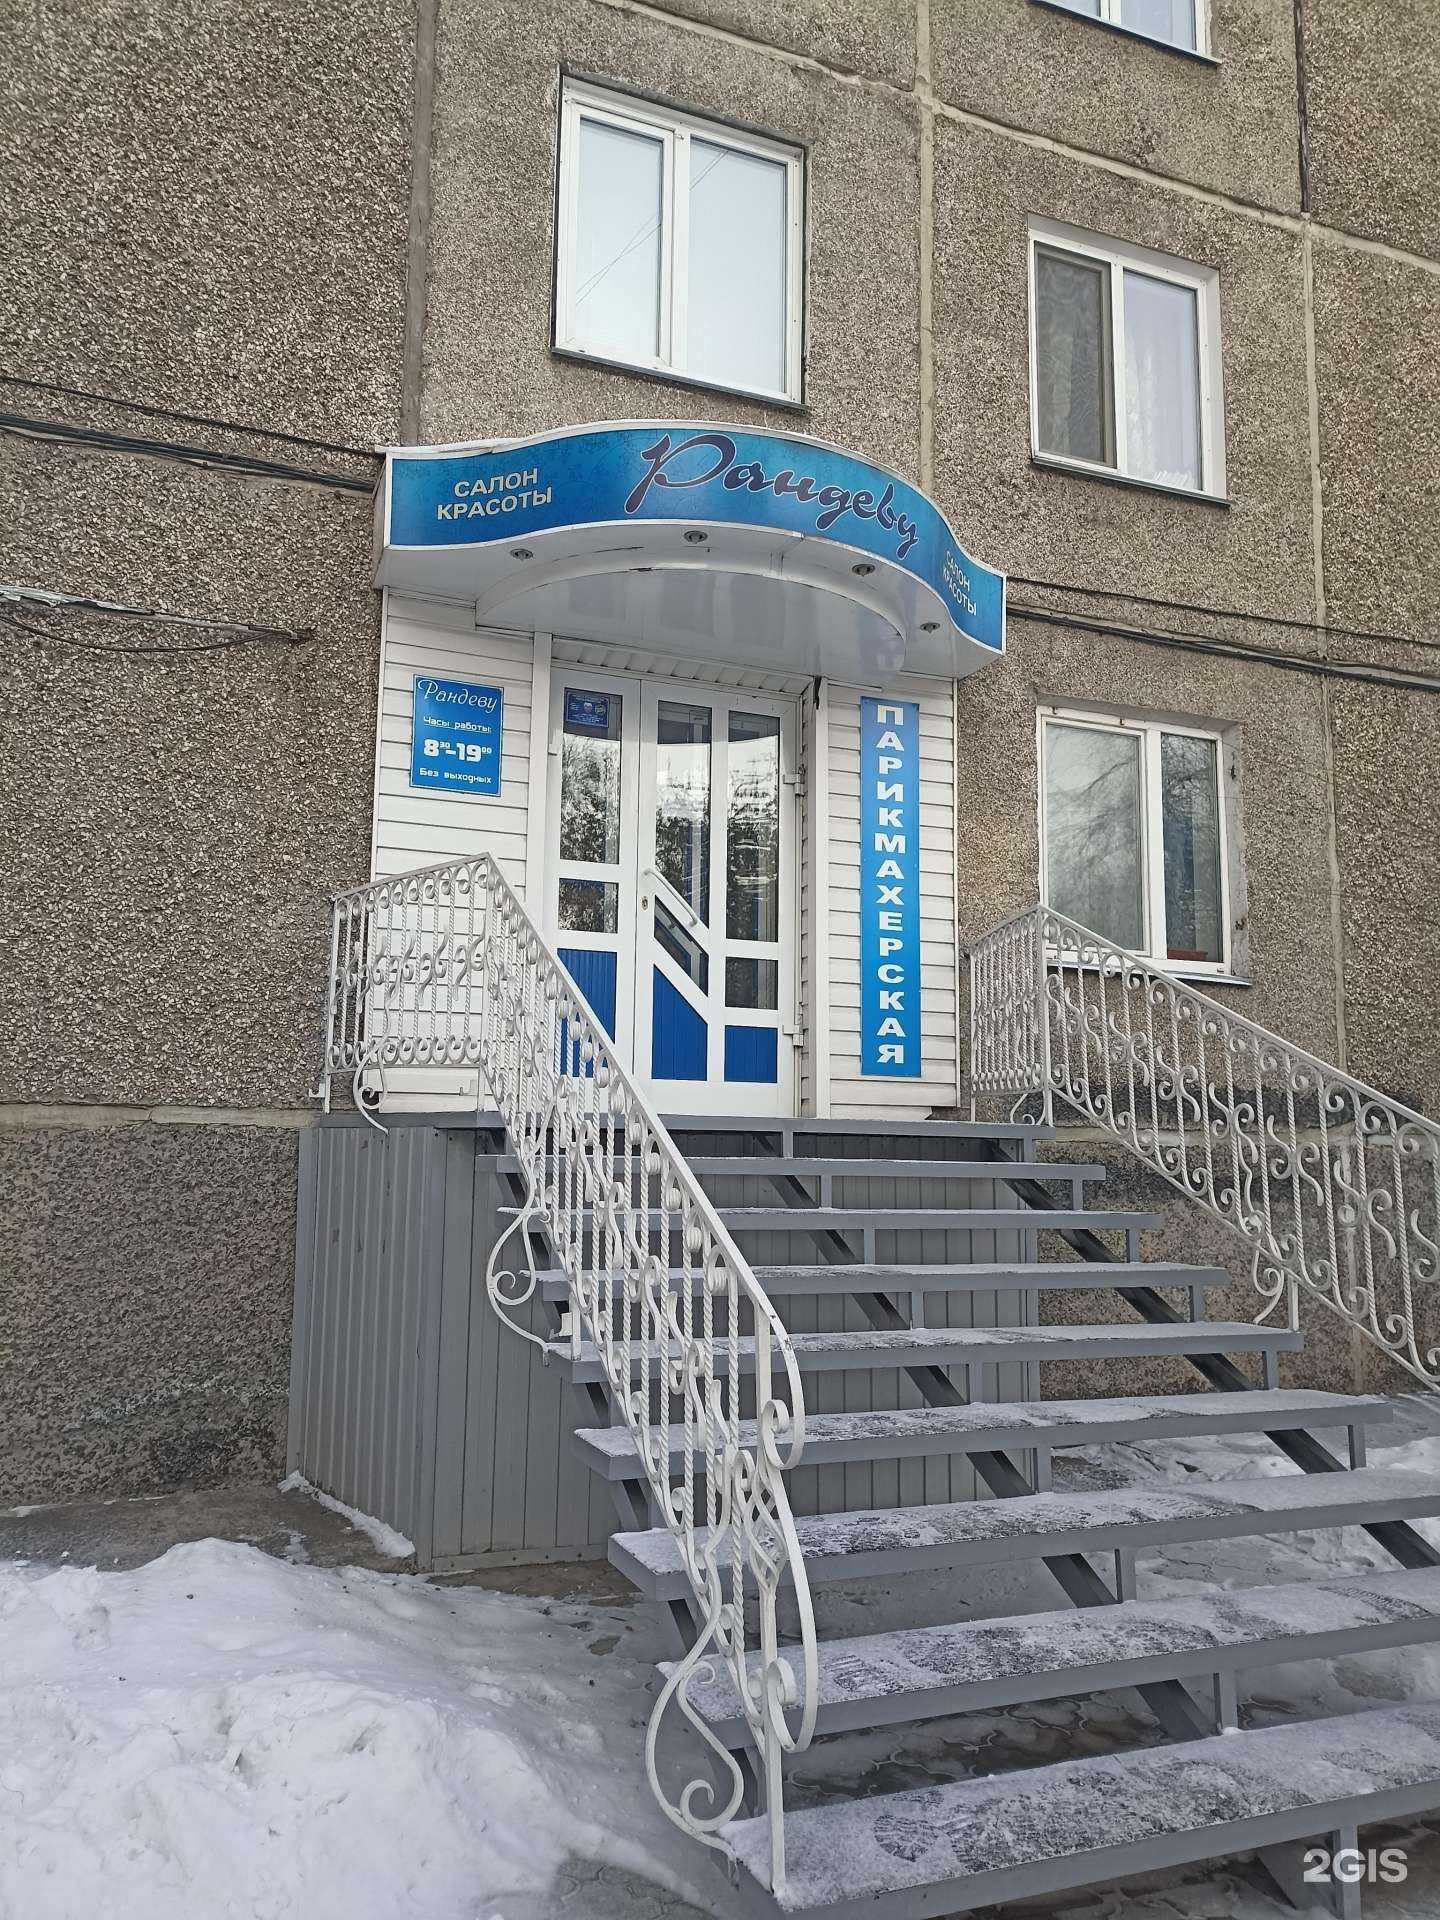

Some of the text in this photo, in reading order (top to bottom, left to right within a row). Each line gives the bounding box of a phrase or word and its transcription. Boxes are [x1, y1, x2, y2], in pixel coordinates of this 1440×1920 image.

[454, 467, 538, 498] САЛОН
[624, 433, 919, 560] Рандеву
[436, 486, 553, 520] КРАСОТЫ
[417, 679, 498, 714] Рандеву
[423, 716, 492, 734] Часы работы:
[419, 767, 492, 785] Без выходных
[873, 703, 906, 1065] ПАРИКМАХЕРСКАЯ
